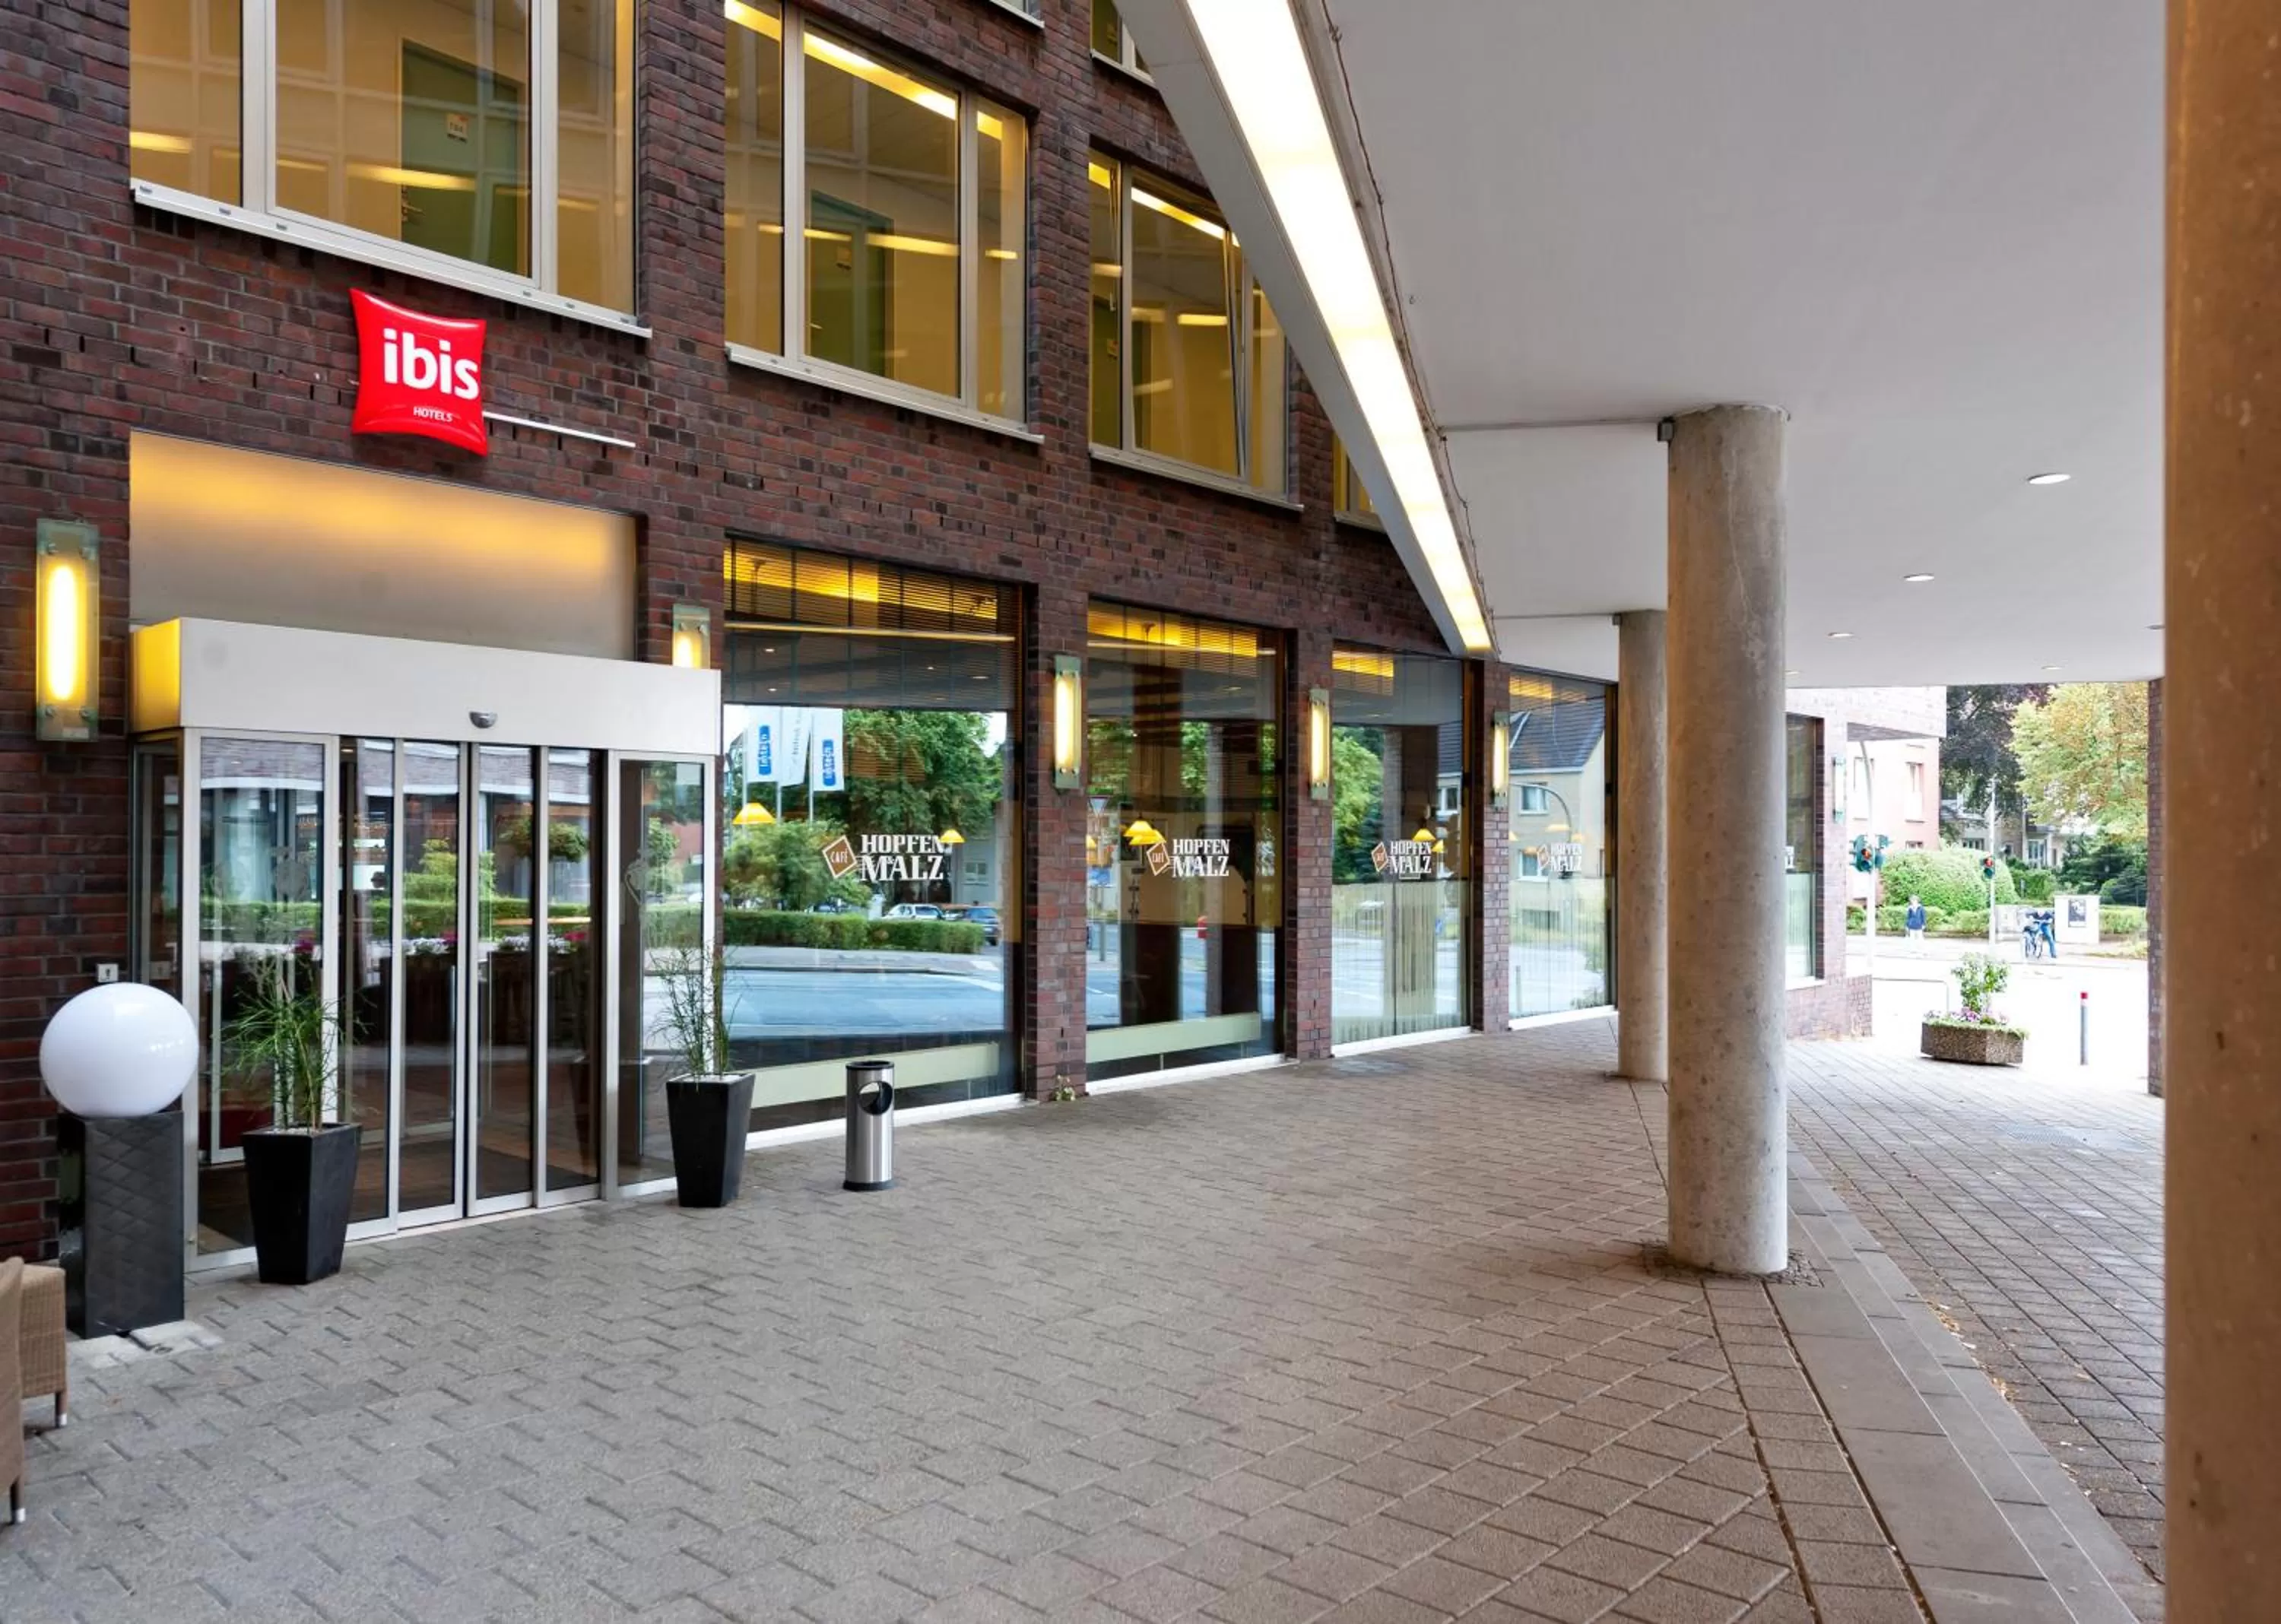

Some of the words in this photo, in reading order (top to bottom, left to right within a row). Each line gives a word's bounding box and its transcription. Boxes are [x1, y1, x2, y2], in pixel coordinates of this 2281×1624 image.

[383, 328, 480, 400] ibis
[413, 406, 454, 423] HOTELS
[861, 834, 945, 854] HOPFEN
[1172, 839, 1230, 855] HOPFEN
[1390, 839, 1432, 855] HOPFEN
[860, 855, 944, 883] MALZ
[1172, 855, 1229, 877] MALZ
[1388, 855, 1432, 874] MALZ
